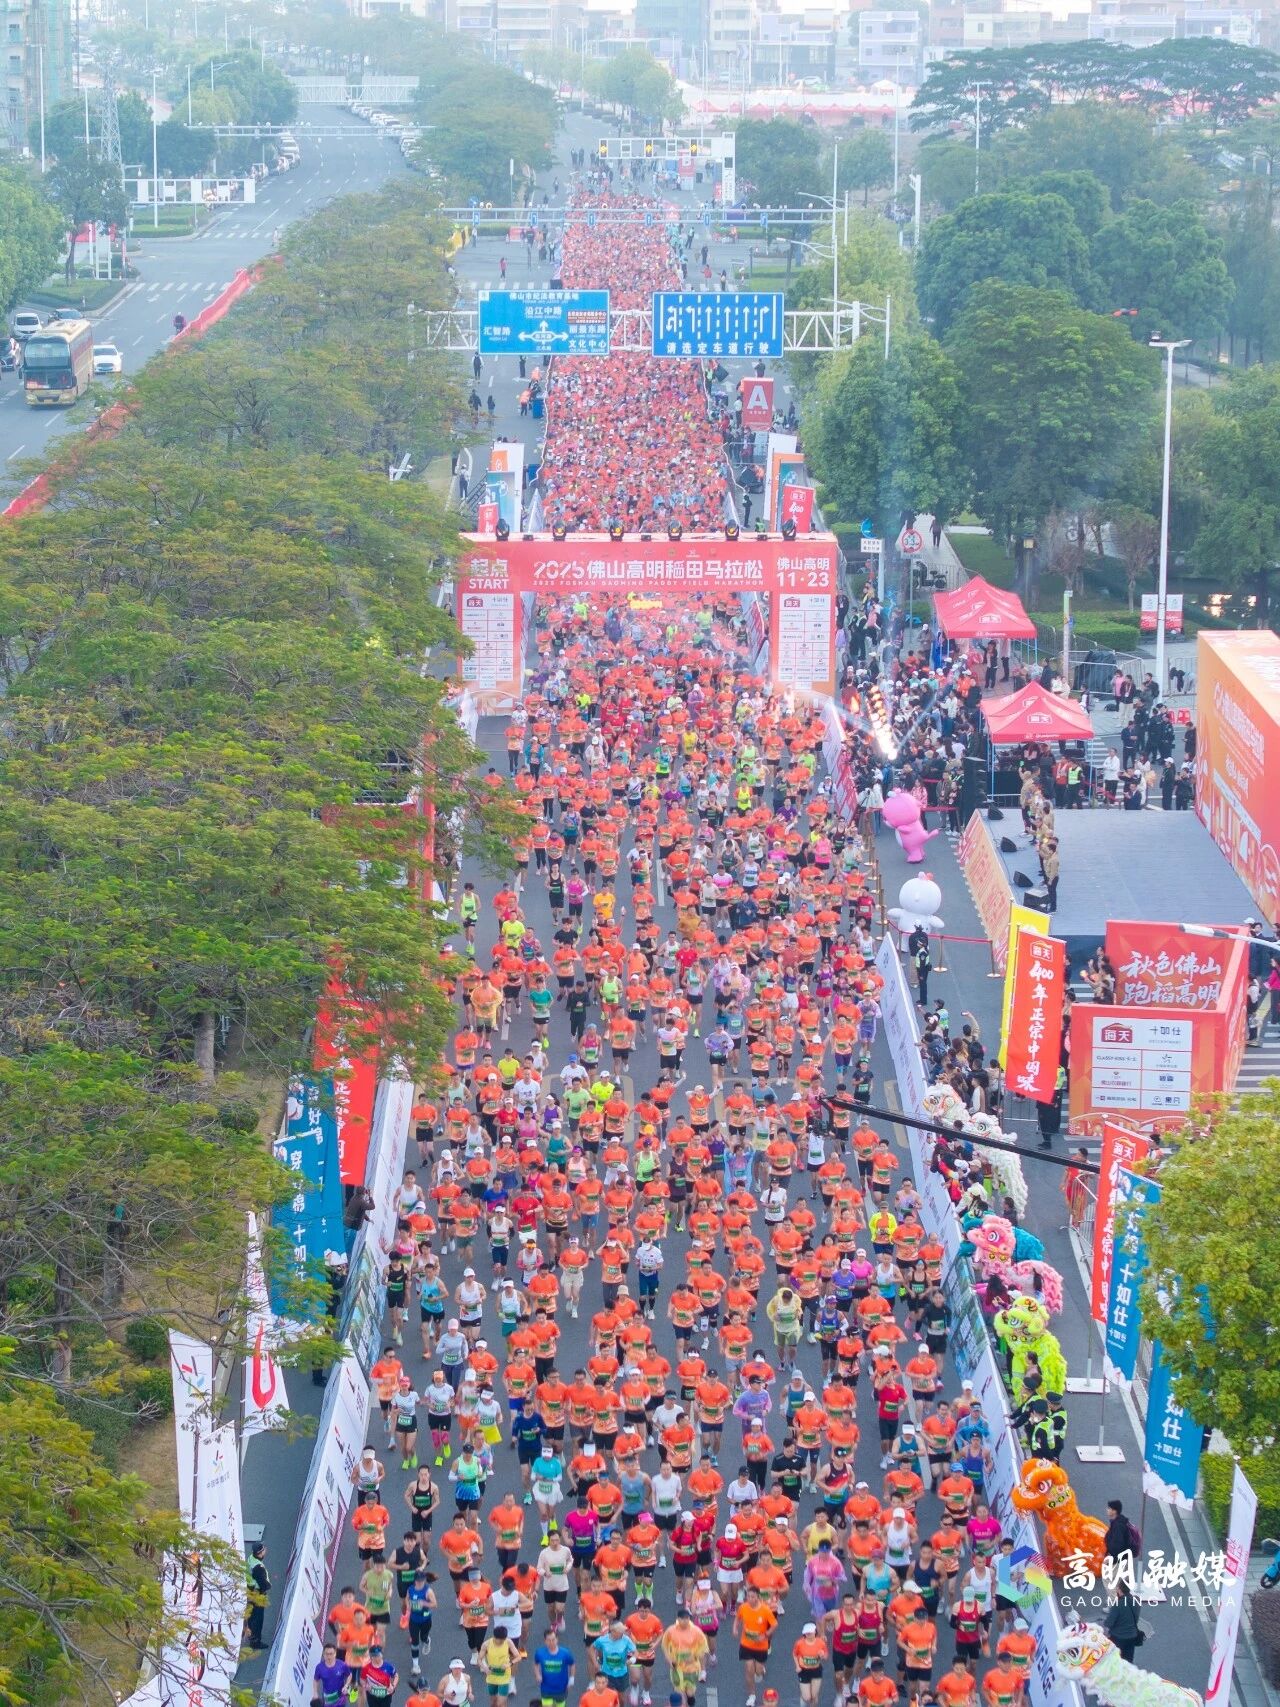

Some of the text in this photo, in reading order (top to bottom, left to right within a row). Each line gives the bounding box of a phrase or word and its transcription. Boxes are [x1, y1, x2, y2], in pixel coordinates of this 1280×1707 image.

[525, 306, 561, 315] 沿江中路
[568, 340, 606, 348] 文化中心
[667, 342, 769, 354] 请选定车道行驶
[747, 385, 768, 410] A
[470, 558, 509, 577] 起点
[777, 557, 830, 571] 佛山高明
[469, 579, 509, 589] START
[1032, 946, 1051, 959] 海天
[1119, 951, 1221, 980] 秋色佛山
[1122, 979, 1221, 1010] 跑稻高明
[1104, 1030, 1130, 1042] 海天
